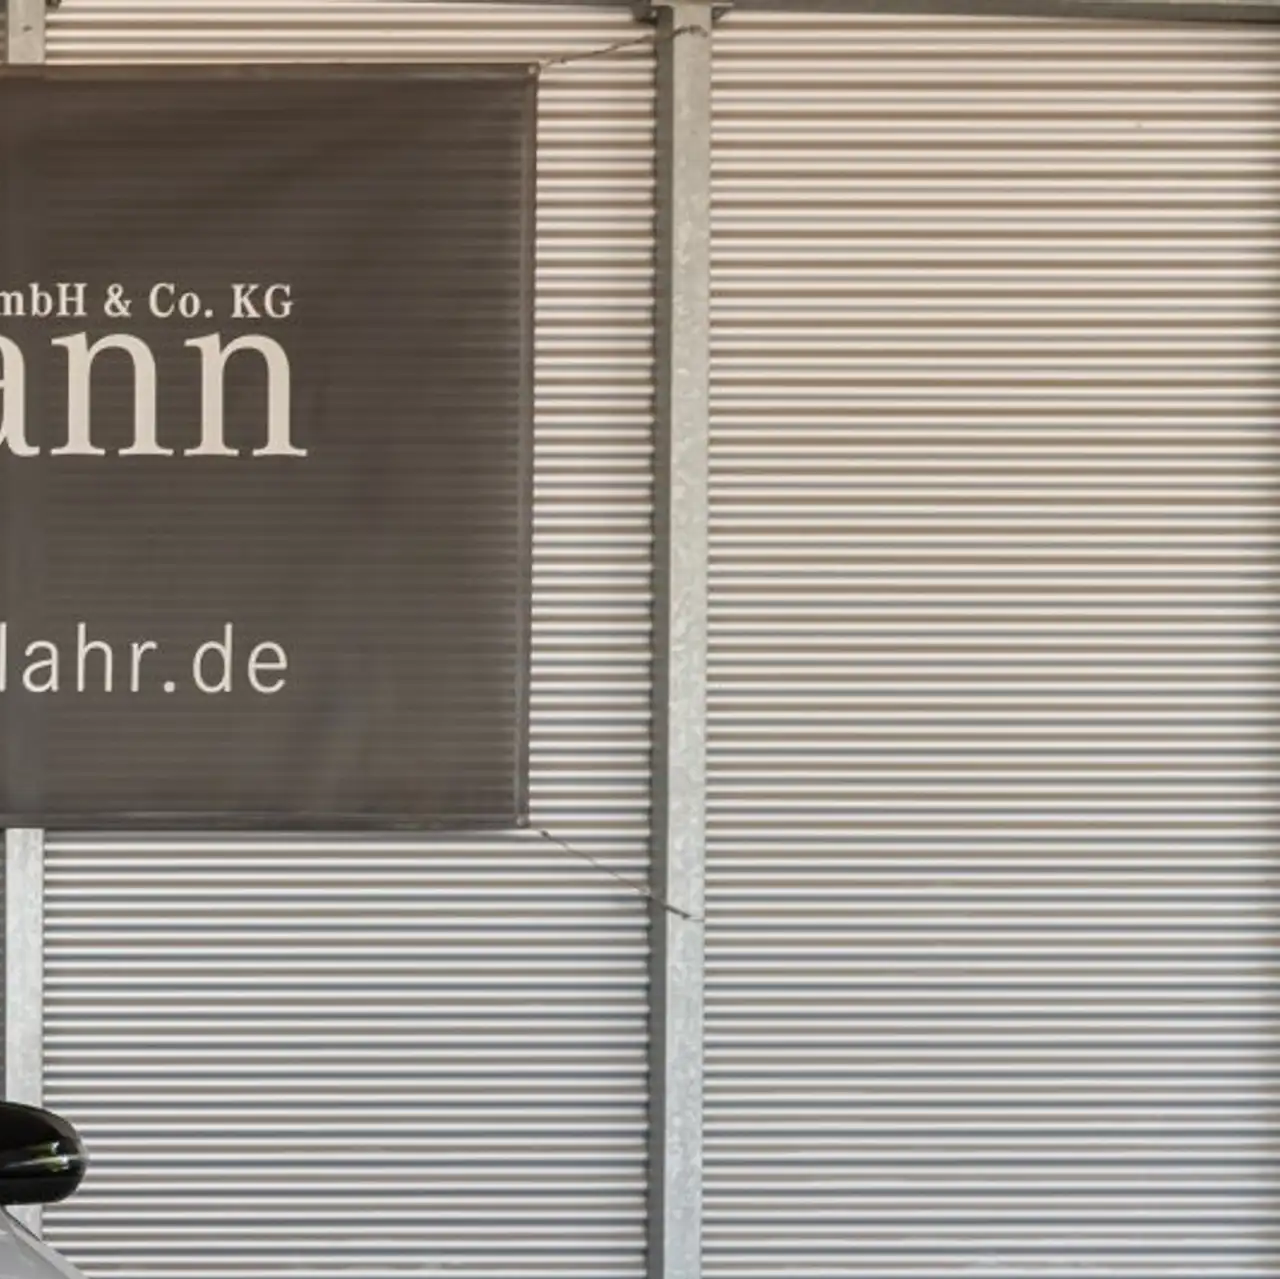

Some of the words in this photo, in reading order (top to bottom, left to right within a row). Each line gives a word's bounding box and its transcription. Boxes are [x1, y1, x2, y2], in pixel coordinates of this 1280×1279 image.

[102, 283, 133, 318] &
[148, 283, 214, 319] Co.
[230, 284, 294, 319] KG
